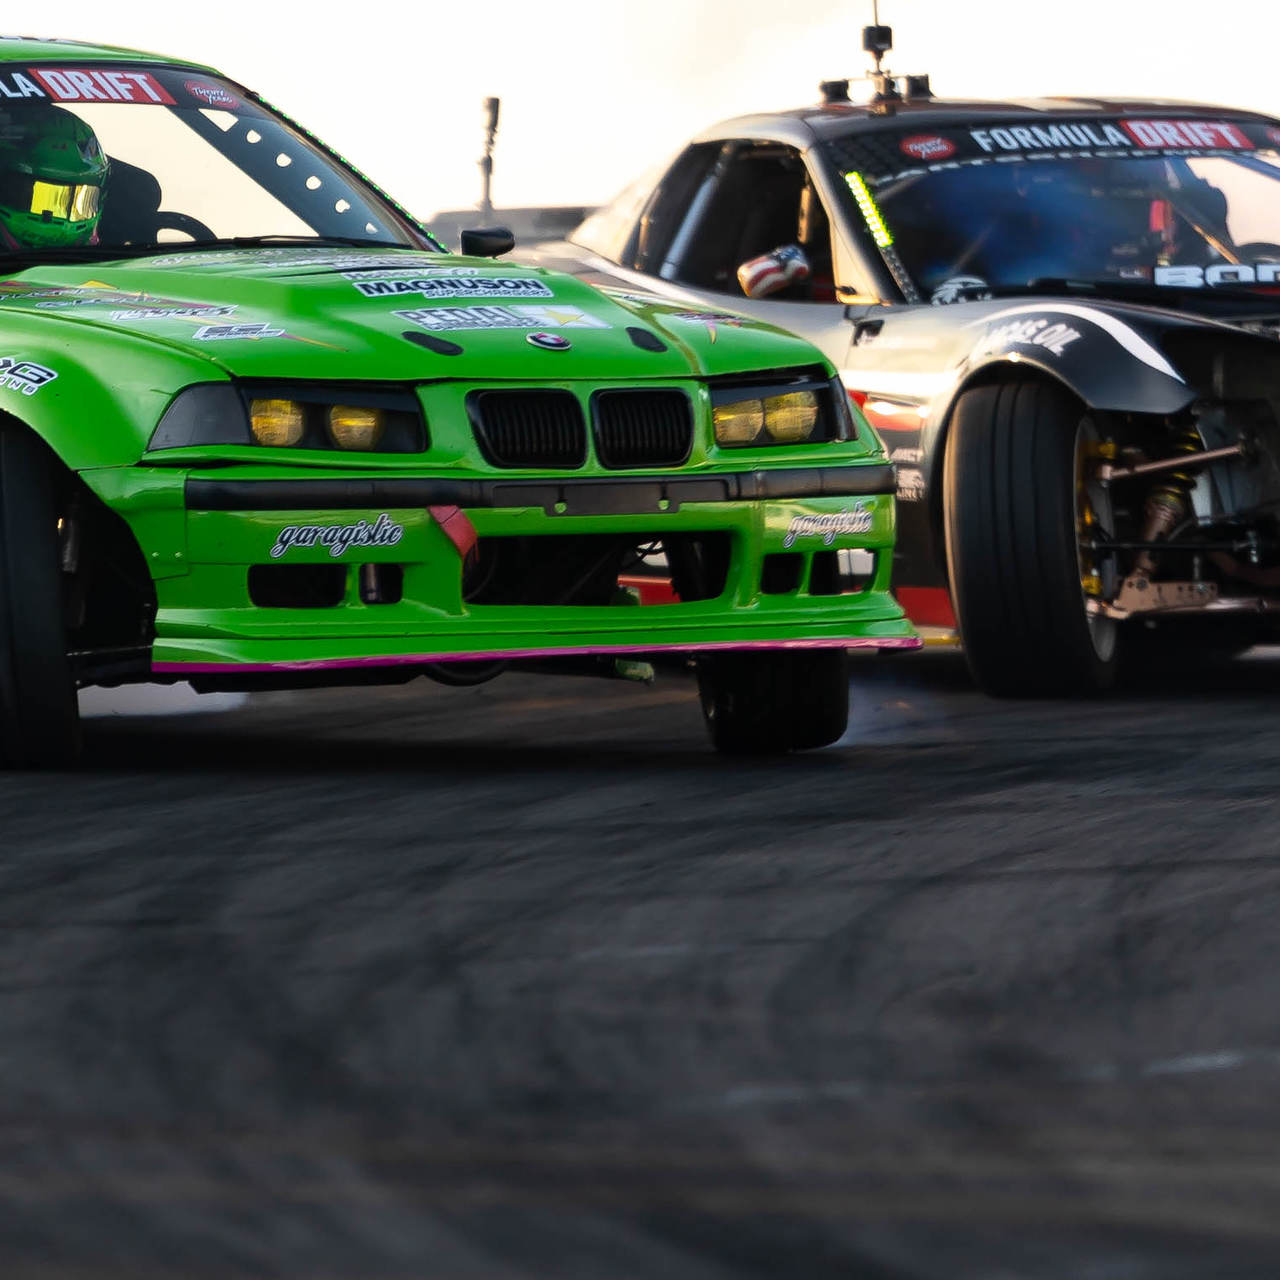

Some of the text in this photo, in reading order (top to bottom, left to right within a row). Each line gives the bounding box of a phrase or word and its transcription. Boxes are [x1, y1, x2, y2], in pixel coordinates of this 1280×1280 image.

[37, 70, 164, 103] DRIFT
[970, 123, 1132, 152] FORMULA
[1125, 121, 1243, 149] DRIFT
[360, 279, 545, 296] MAGNUSON
[394, 306, 521, 321] PEDAL
[270, 512, 404, 559] garagistic
[783, 500, 873, 549] garagistic
